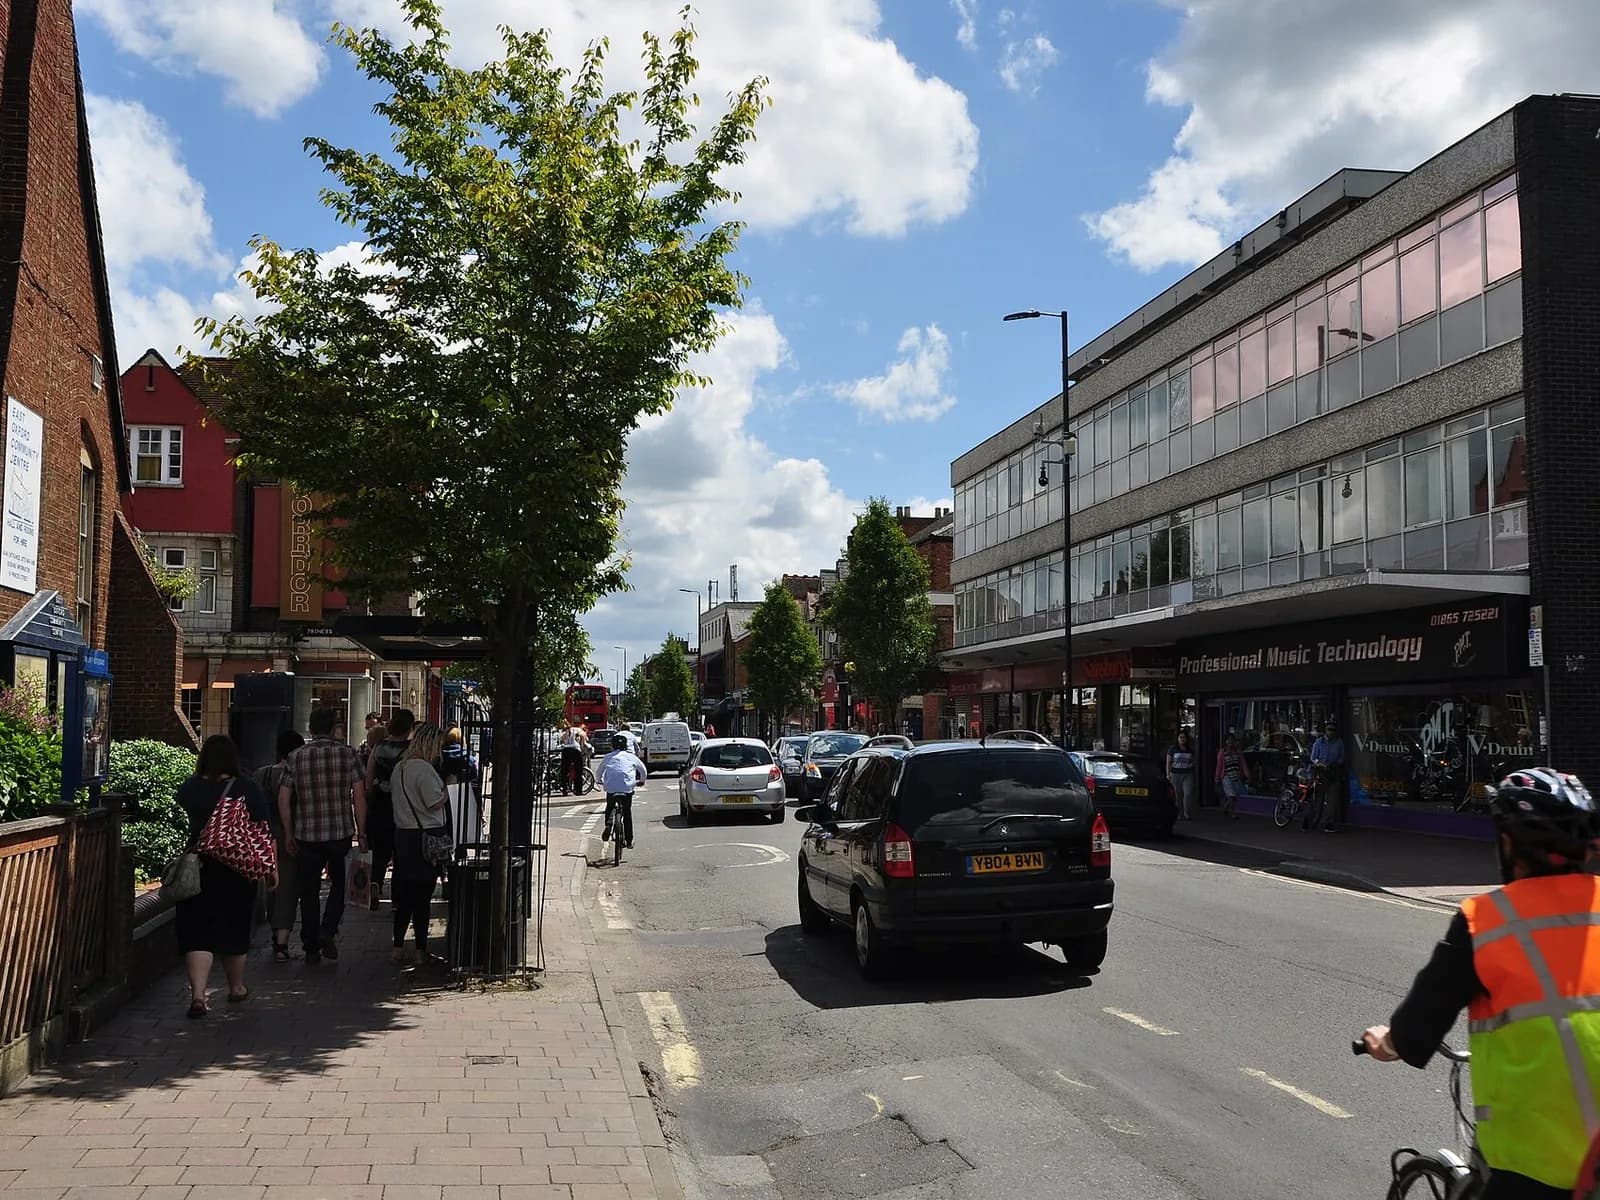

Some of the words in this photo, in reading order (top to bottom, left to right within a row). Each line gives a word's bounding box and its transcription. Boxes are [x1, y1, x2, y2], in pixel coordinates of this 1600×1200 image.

[12, 407, 26, 423] EAST
[11, 422, 31, 441] OXFORD
[10, 437, 39, 462] COMMUNITY
[10, 454, 30, 472] CENTRE
[290, 490, 312, 612] ORRIDOR
[1430, 612, 1460, 626] 01865
[1462, 607, 1499, 623] 725221
[1179, 648, 1263, 675] Professional
[1267, 643, 1311, 669] Music
[1317, 635, 1423, 662] Technology
[974, 856, 1011, 871] YB04
[1014, 853, 1043, 868] BVN
